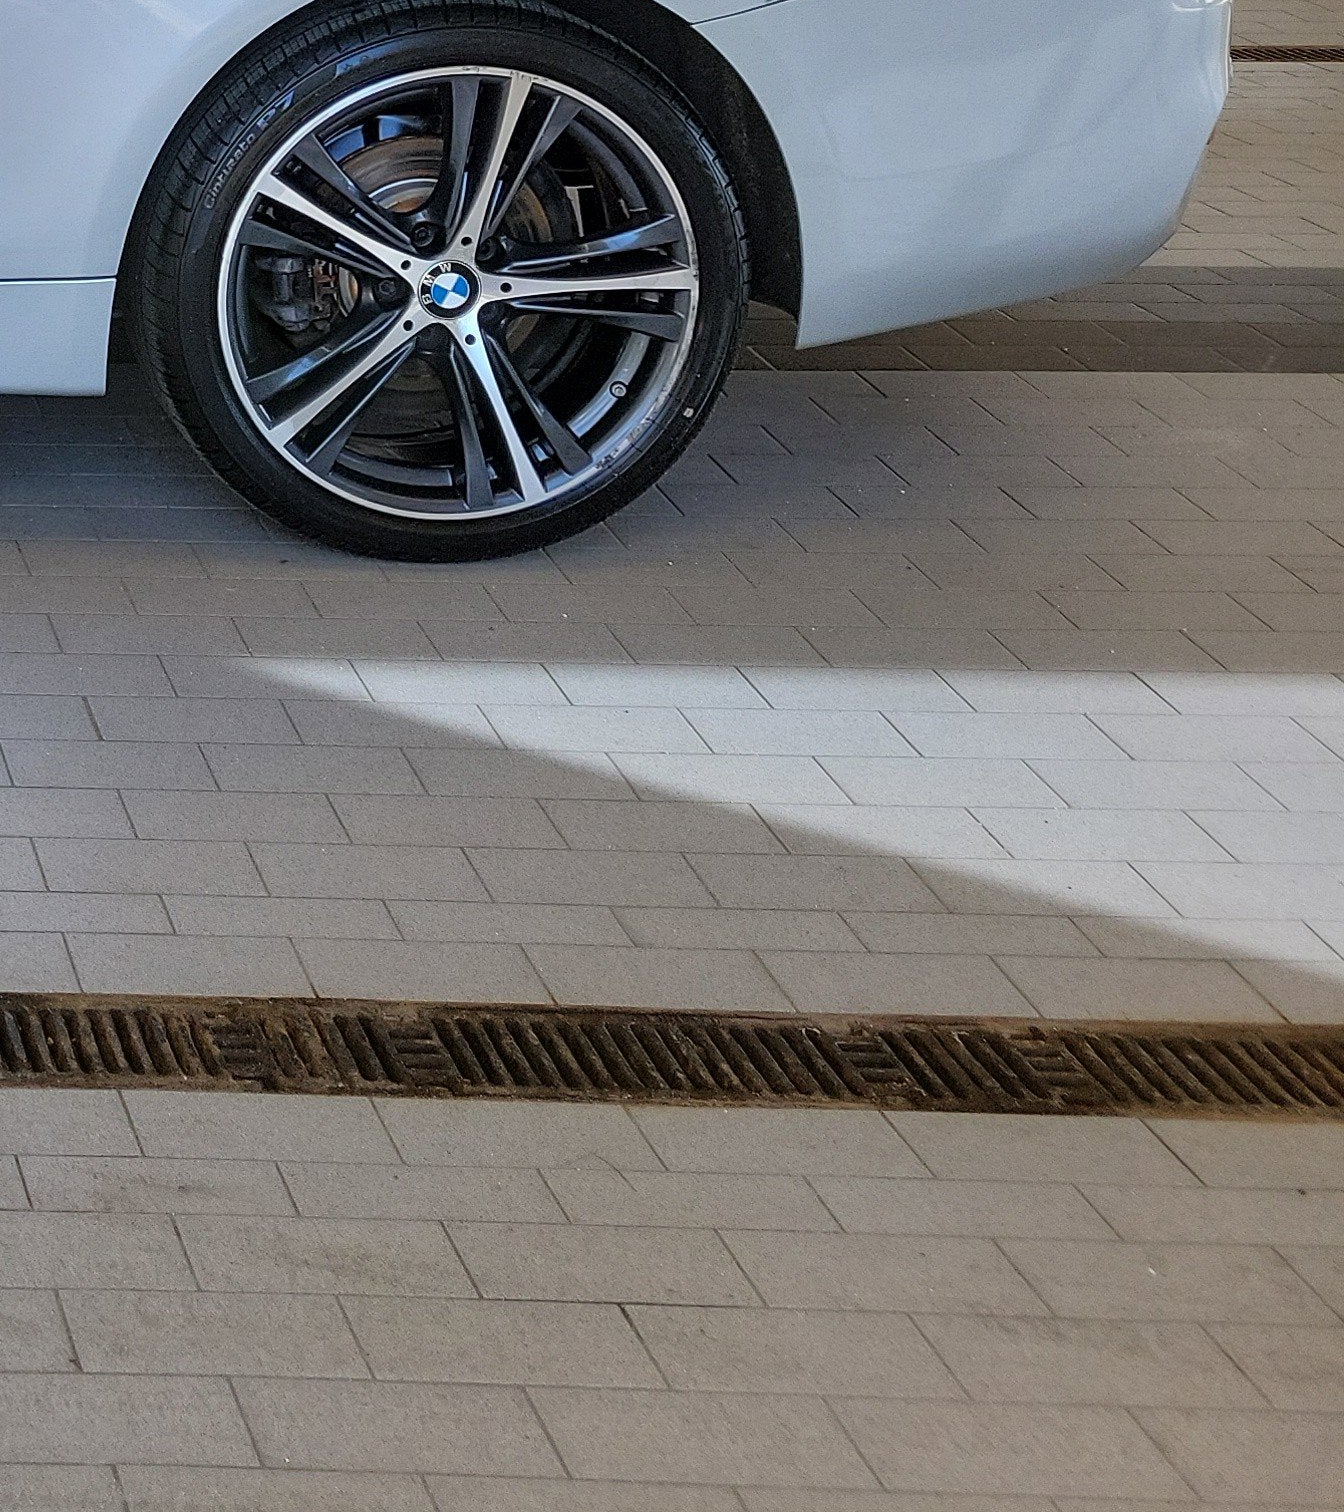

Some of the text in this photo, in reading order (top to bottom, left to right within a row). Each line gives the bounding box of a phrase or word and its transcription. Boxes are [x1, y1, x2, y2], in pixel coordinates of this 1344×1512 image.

[204, 88, 296, 209] Cinturato P7
[422, 262, 452, 305] BMW
